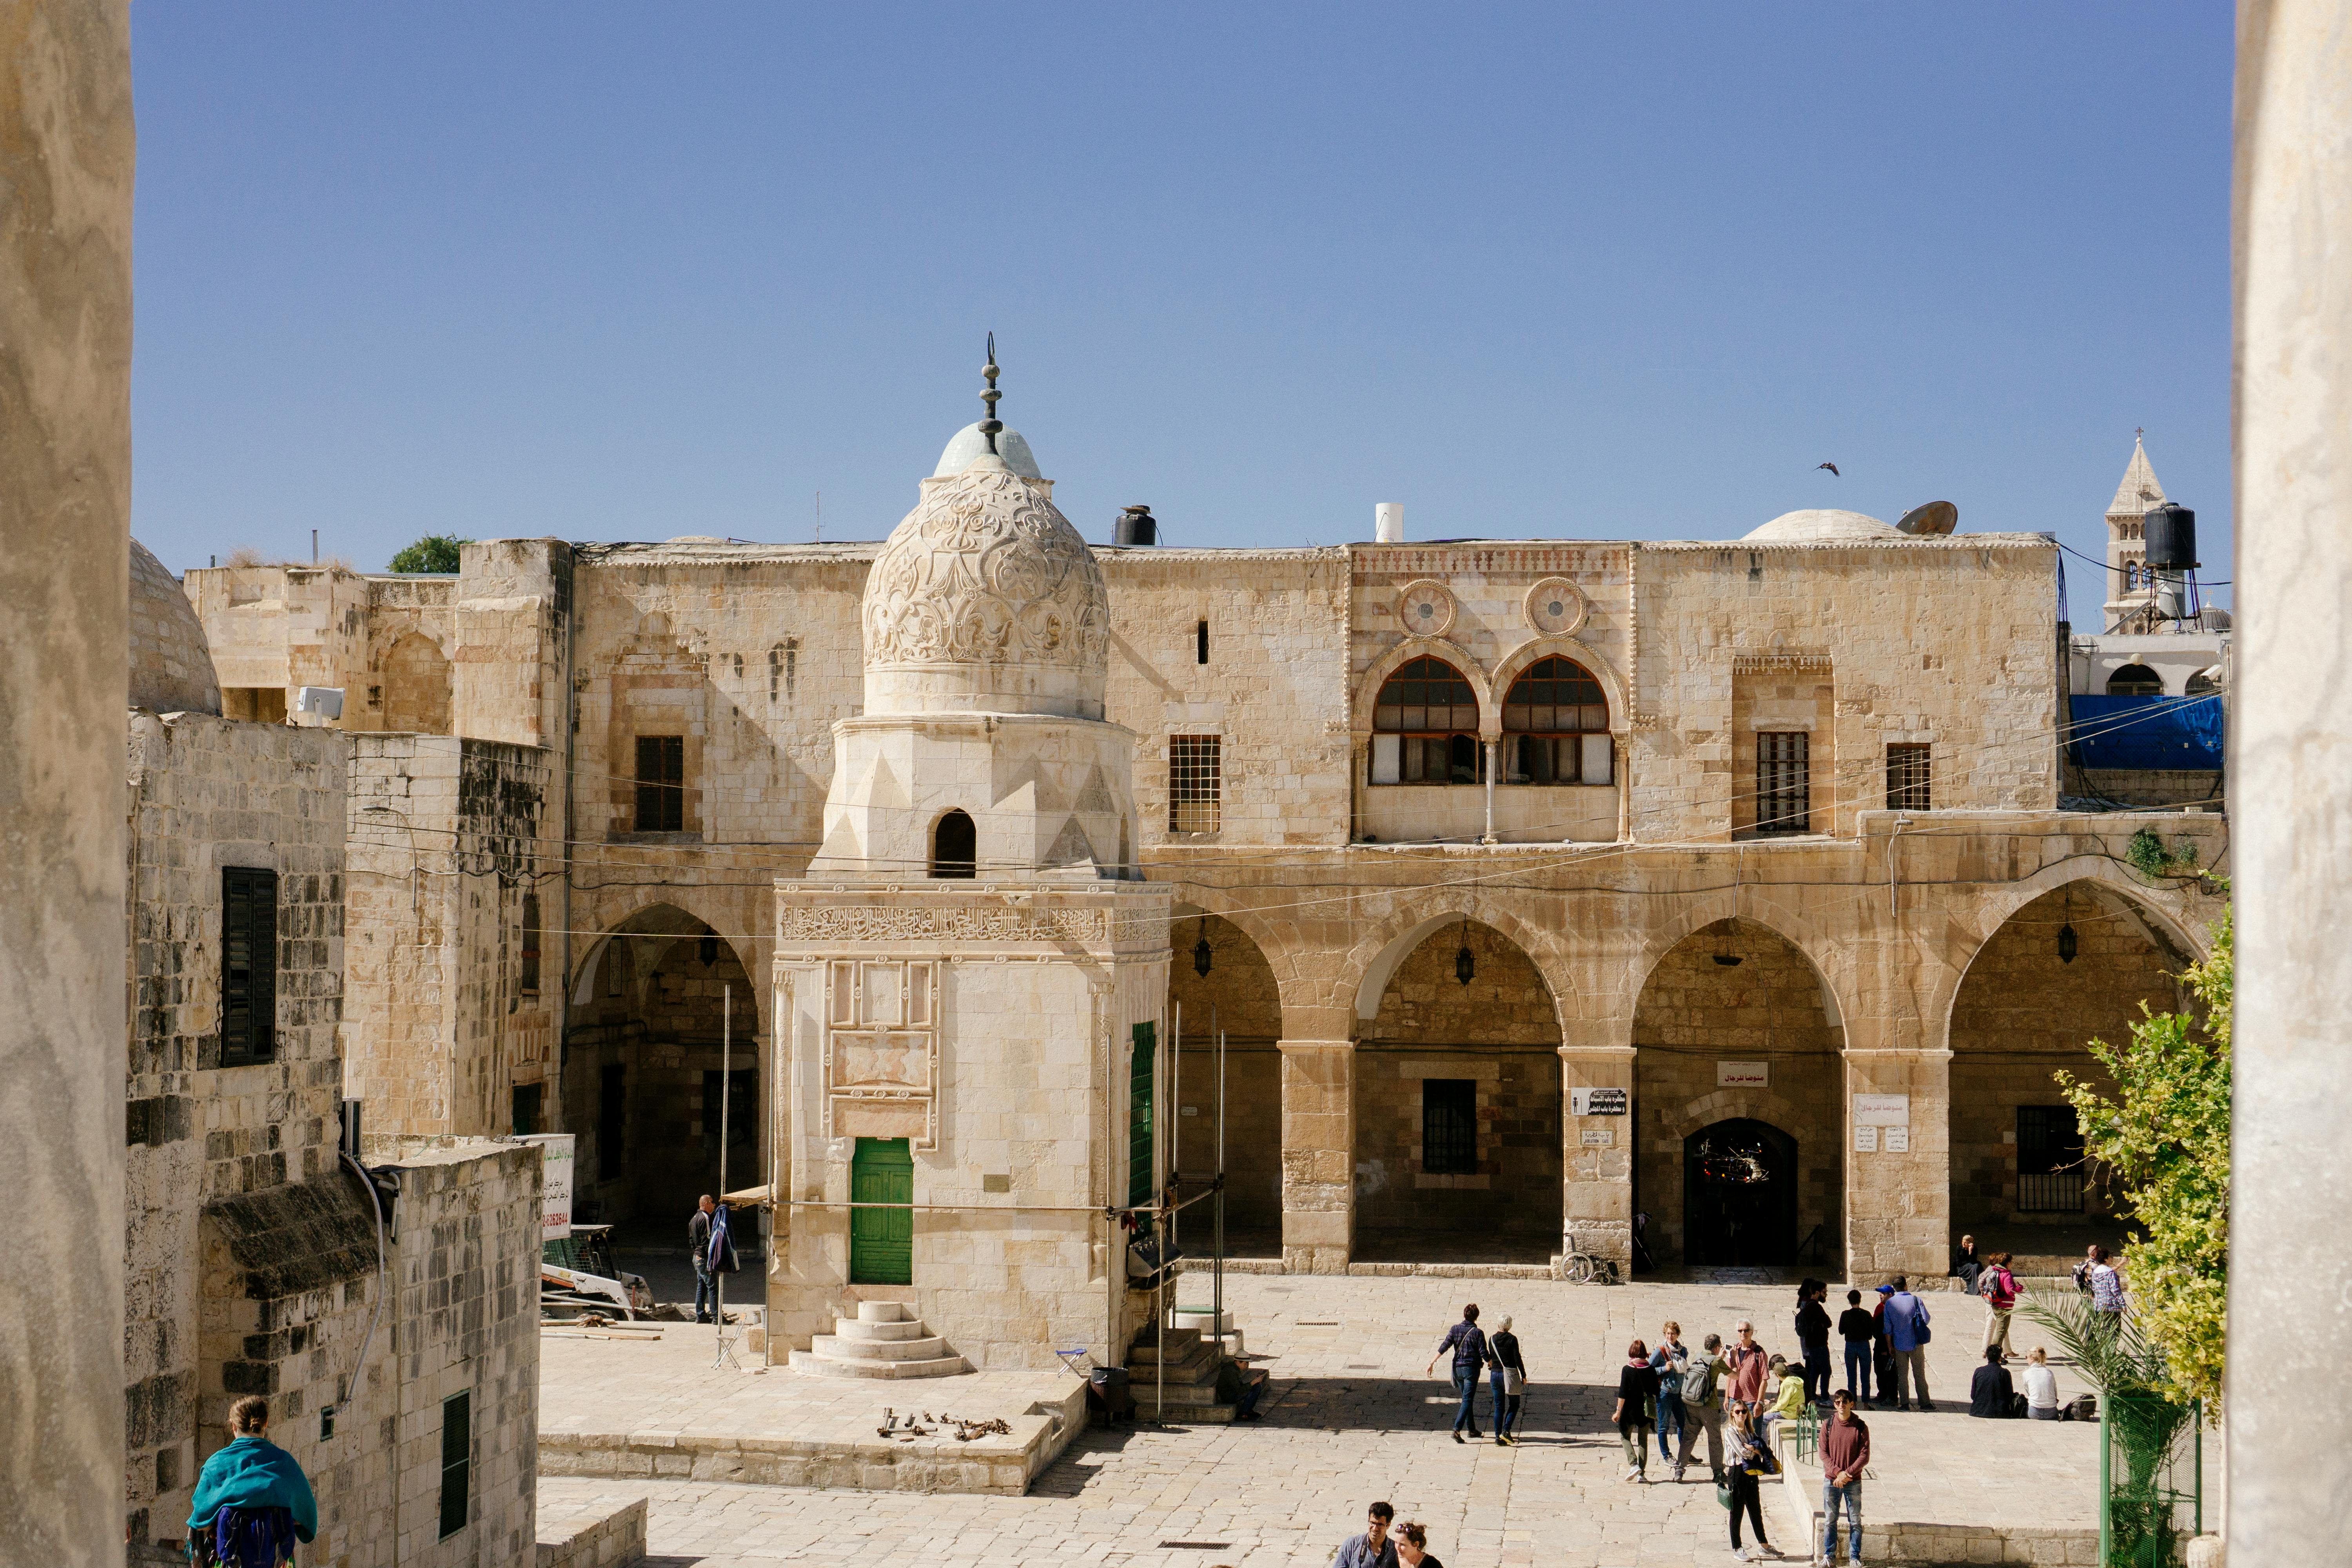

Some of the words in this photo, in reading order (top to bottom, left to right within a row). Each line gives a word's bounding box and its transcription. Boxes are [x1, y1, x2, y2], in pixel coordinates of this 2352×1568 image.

[1745, 1073, 1764, 1082] متوضأ
[1861, 1104, 1882, 1112] للرجال
[1883, 1103, 1903, 1112] متوضأ
[553, 1178, 563, 1190] مركز
